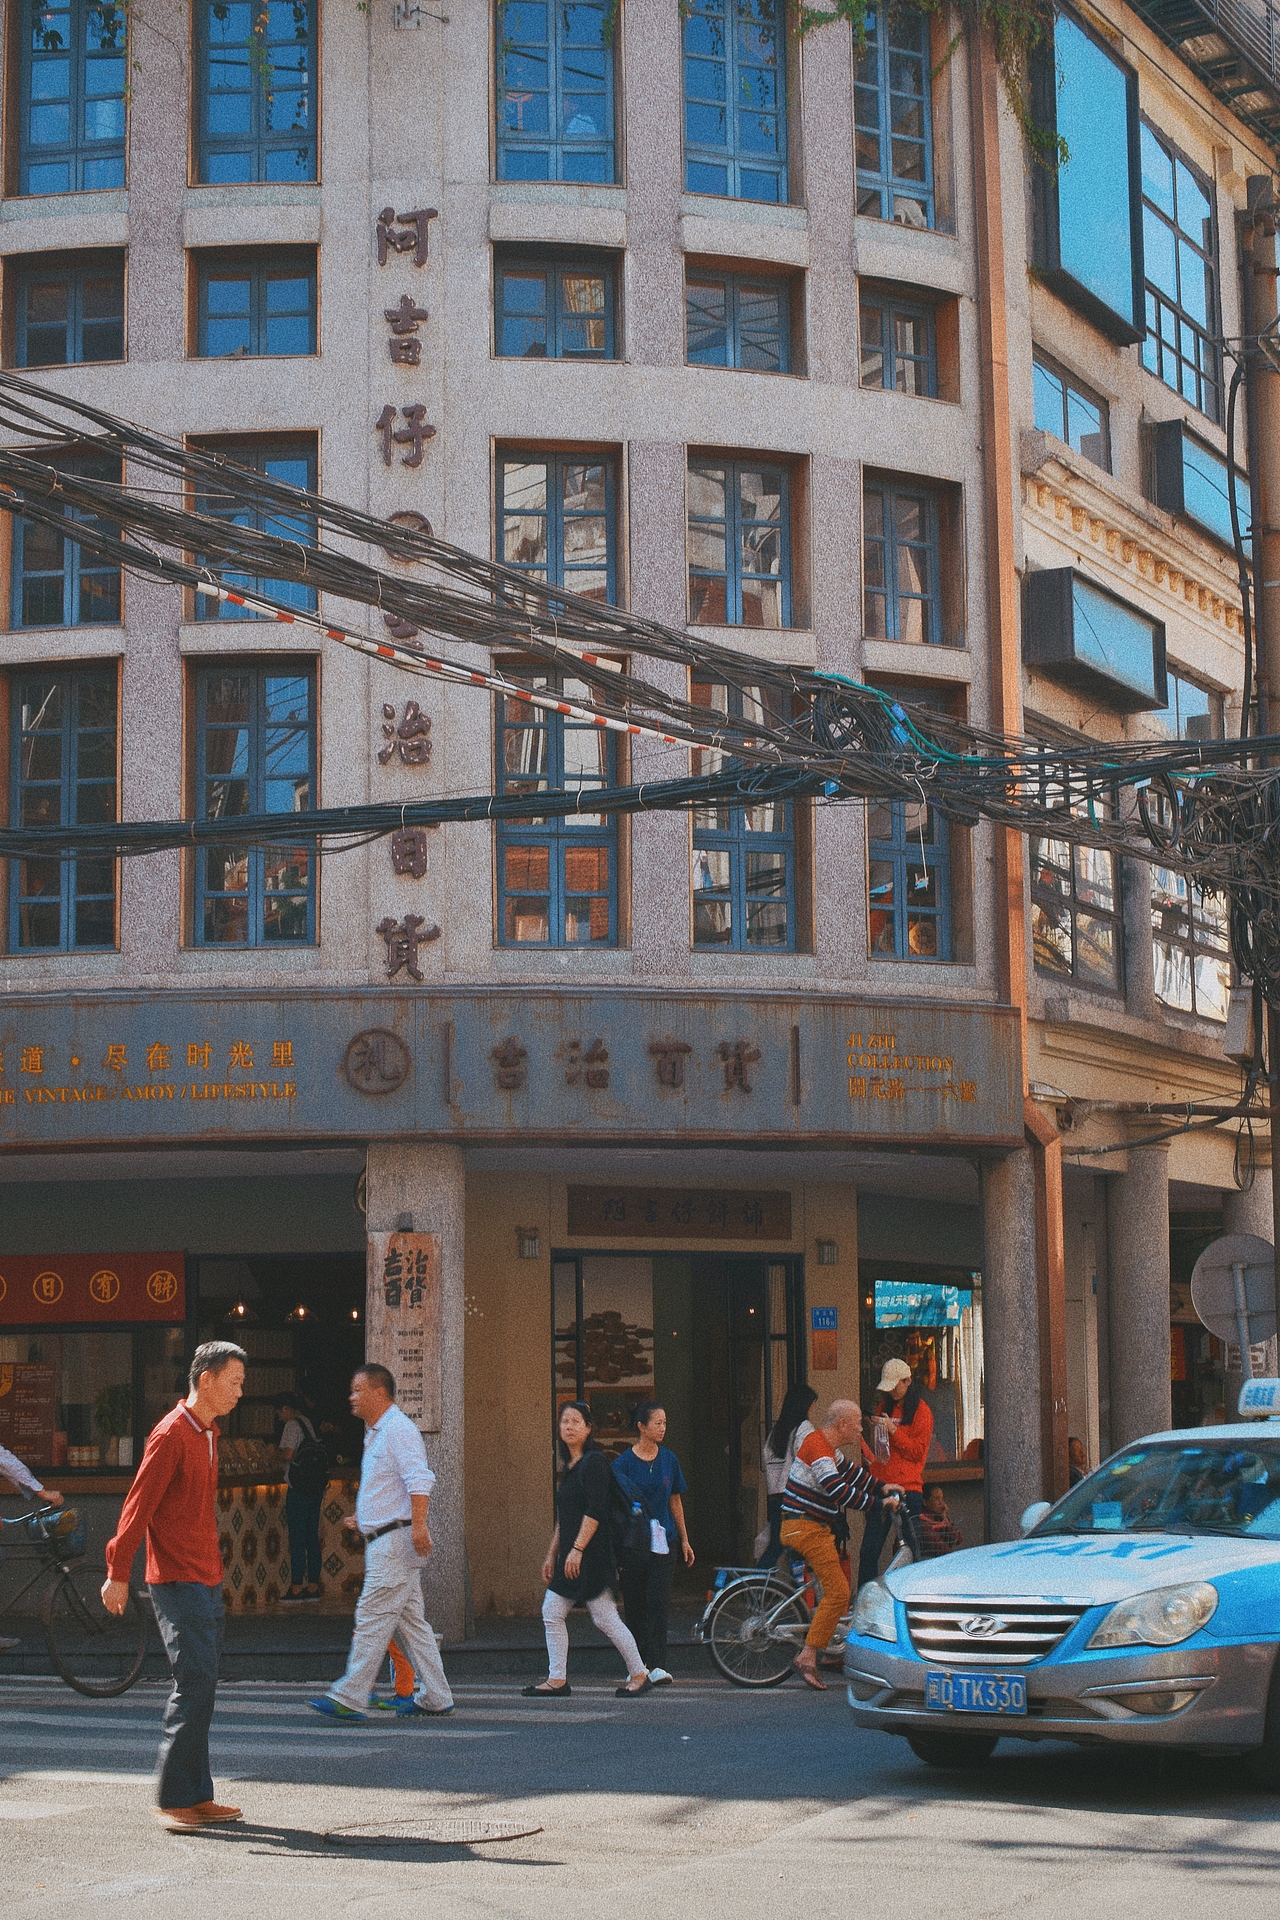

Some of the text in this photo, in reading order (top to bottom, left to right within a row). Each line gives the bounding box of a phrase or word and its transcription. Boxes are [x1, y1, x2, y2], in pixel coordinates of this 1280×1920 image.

[376, 206, 438, 468] 阿吉仔
[846, 1033, 896, 1049] JI ZHI
[846, 1053, 955, 1071] COLLECTION
[190, 1081, 296, 1100] LIFESTYLE
